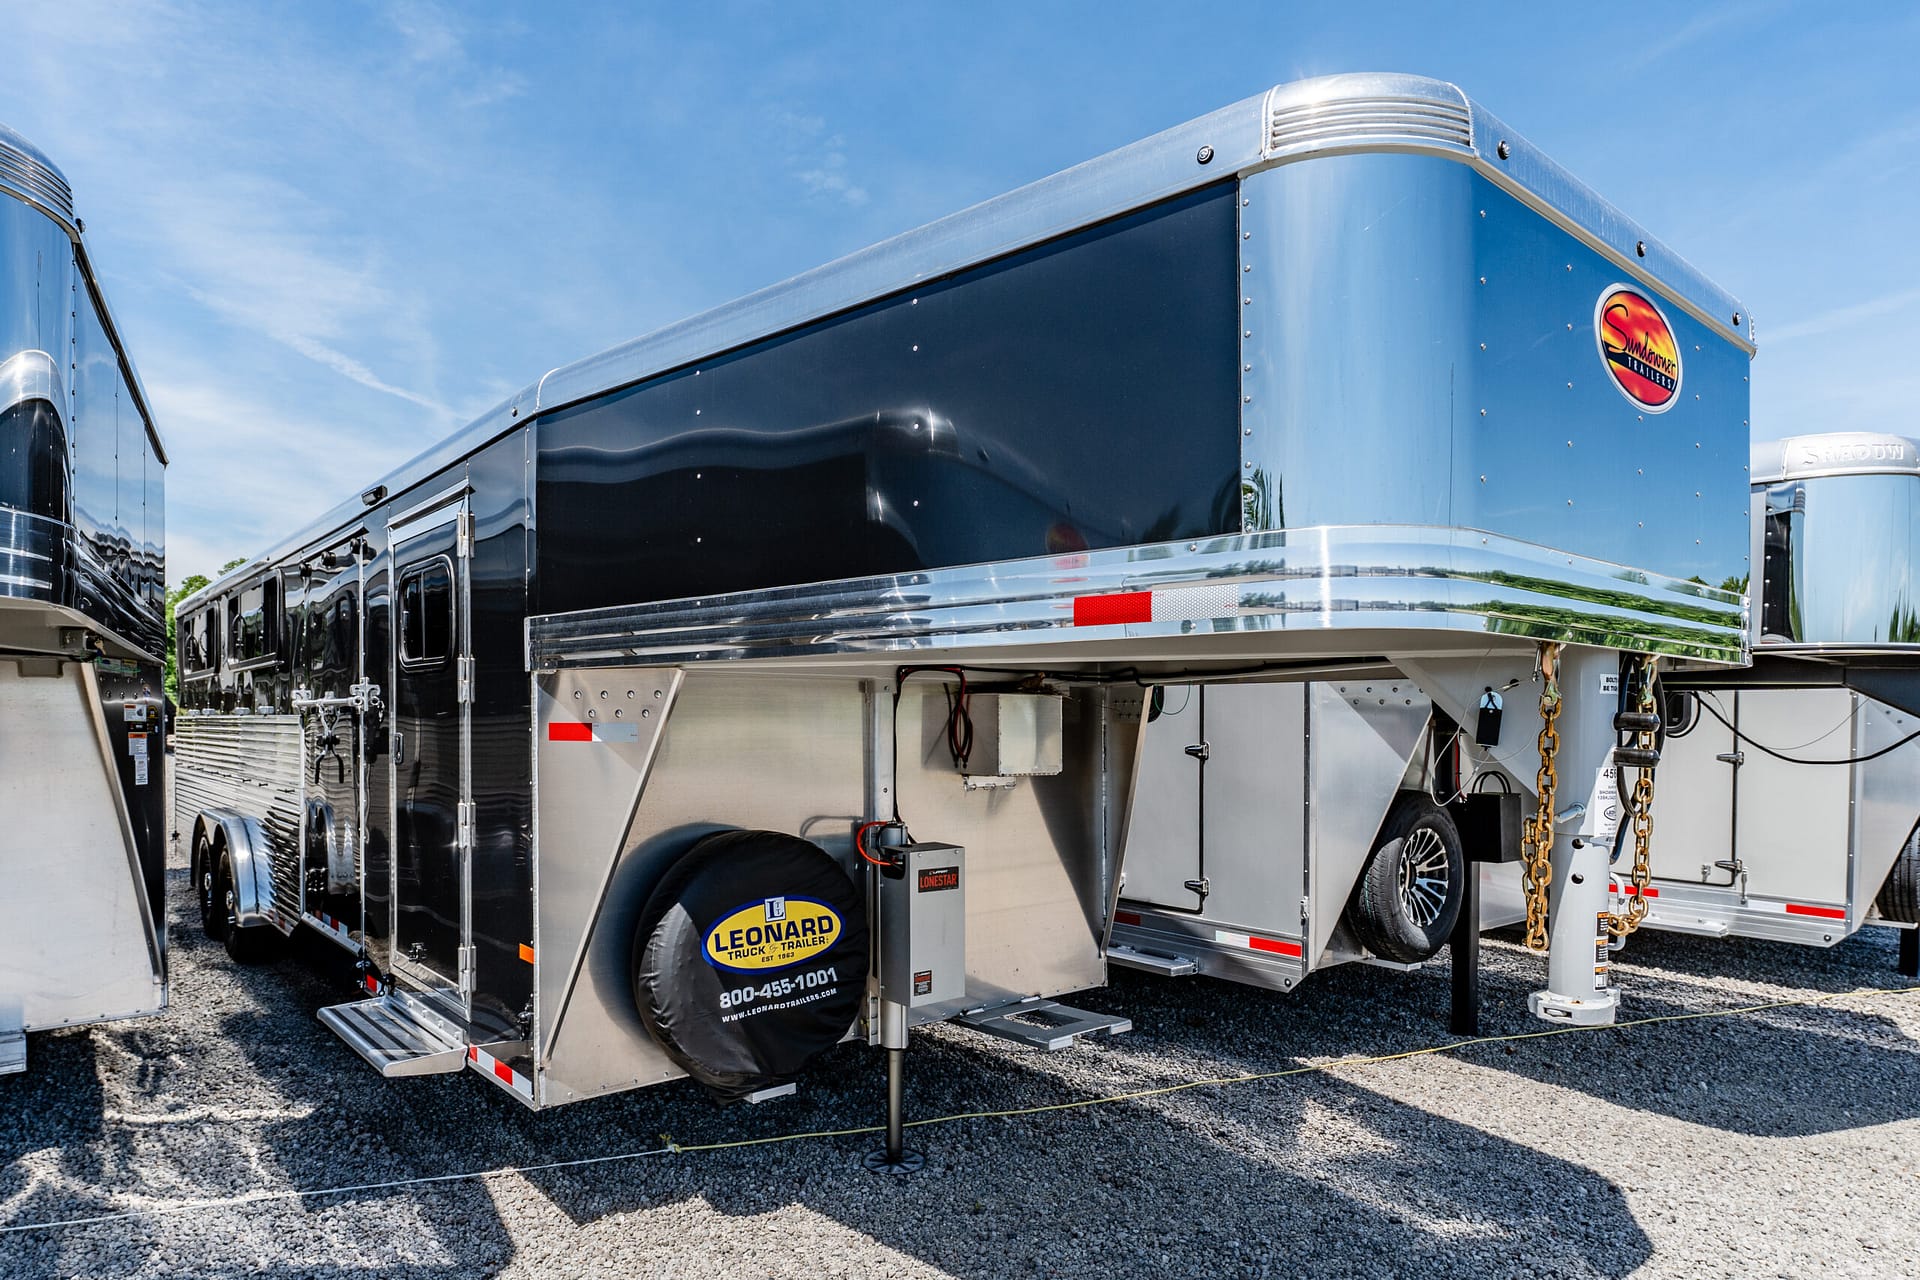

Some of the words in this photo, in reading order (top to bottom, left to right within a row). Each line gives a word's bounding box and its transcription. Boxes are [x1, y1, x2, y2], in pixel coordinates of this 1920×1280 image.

[1604, 303, 1676, 377] Sundowner
[1628, 356, 1671, 389] TRAILERS
[919, 873, 957, 889] LONESTAR
[714, 915, 834, 953] LEONARD
[727, 945, 766, 961] TRUCK
[781, 935, 826, 951] TRAILER
[761, 955, 774, 963] EST
[719, 967, 838, 1009] 800-455-1001
